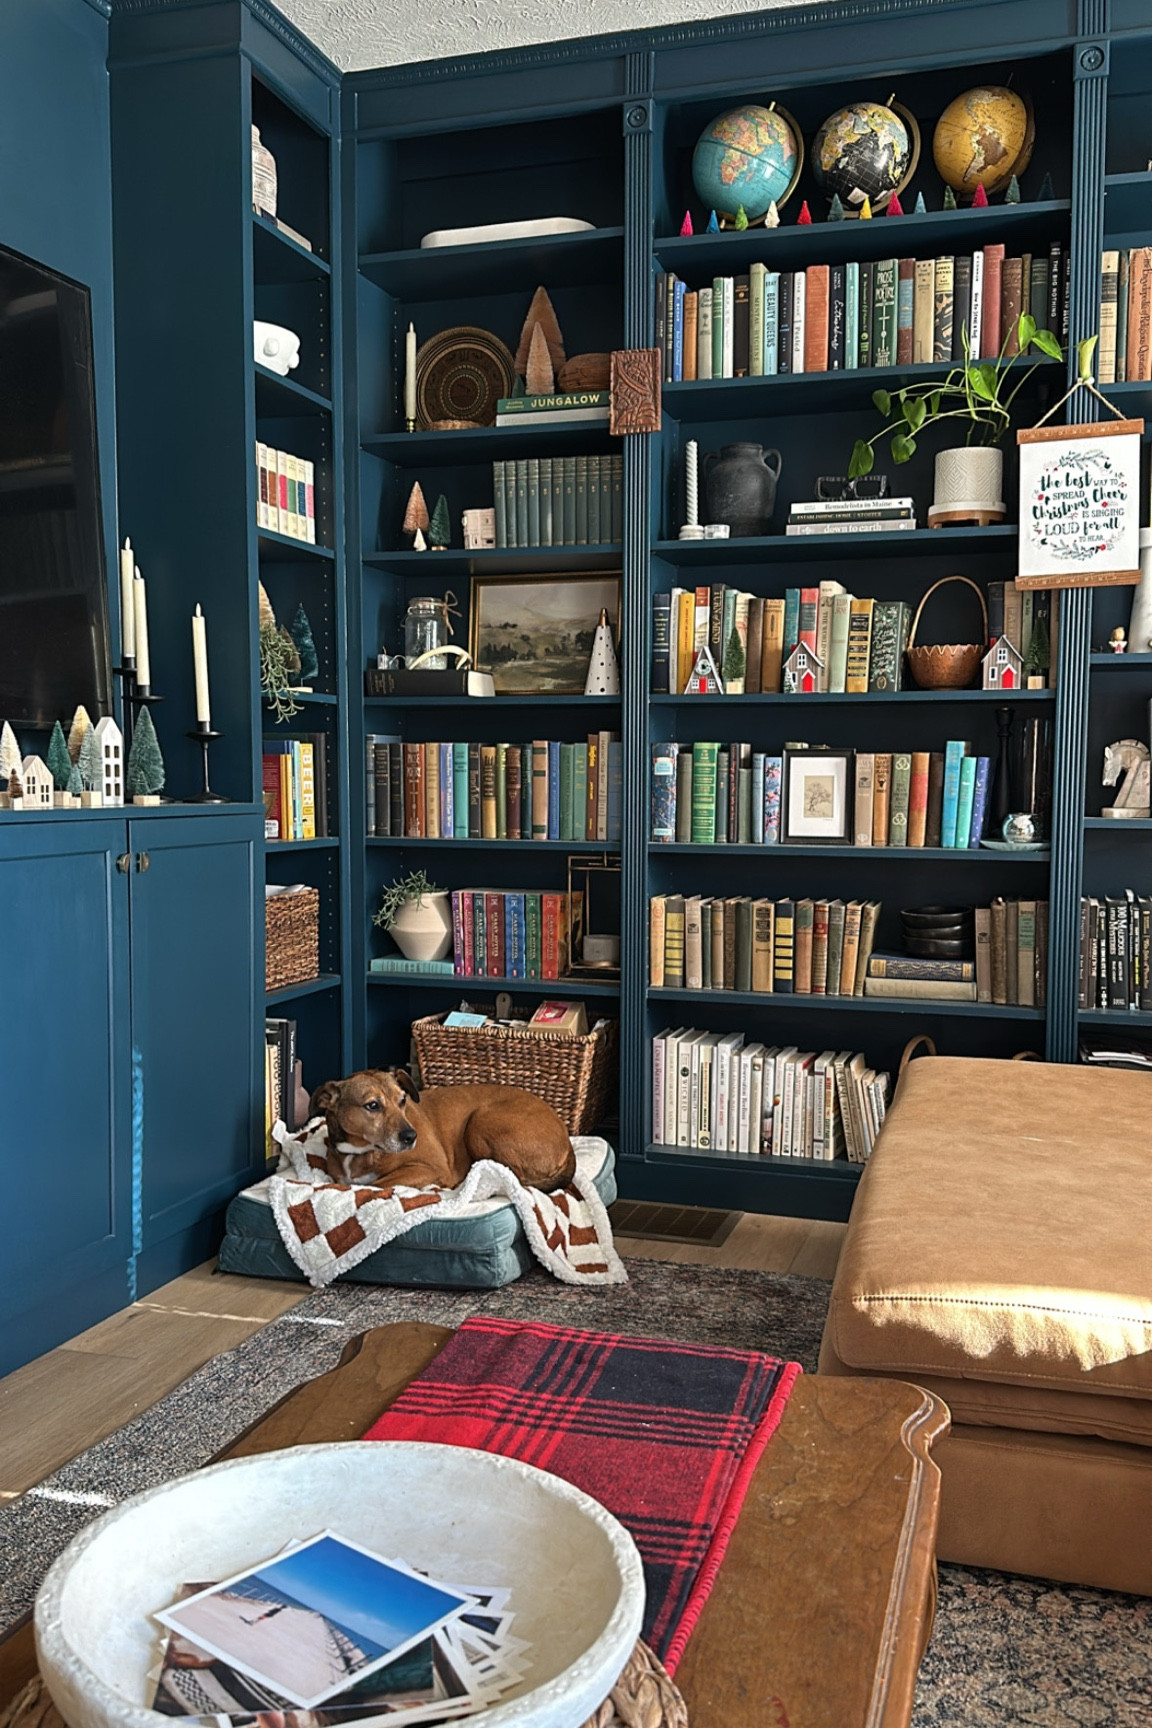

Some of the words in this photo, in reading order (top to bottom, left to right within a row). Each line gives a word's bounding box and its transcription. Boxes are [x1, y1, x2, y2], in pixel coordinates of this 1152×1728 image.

[767, 292, 776, 319] BEAUTY
[767, 321, 775, 348] QUEENS
[530, 394, 600, 408] JUNGALOW
[1065, 471, 1093, 488] best
[1052, 490, 1085, 500] SPREAD
[1091, 508, 1125, 518] SINGING
[824, 524, 847, 533] down
[849, 524, 858, 532] to
[858, 522, 882, 532] earth
[1044, 523, 1080, 536] LOUD
[713, 590, 722, 613] TURN
[712, 622, 720, 644] MIND
[303, 754, 312, 804] BEER
[1118, 906, 1127, 918] 100
[1109, 921, 1118, 955] MYSTERIES
[1118, 919, 1127, 955] MALICIOUS
